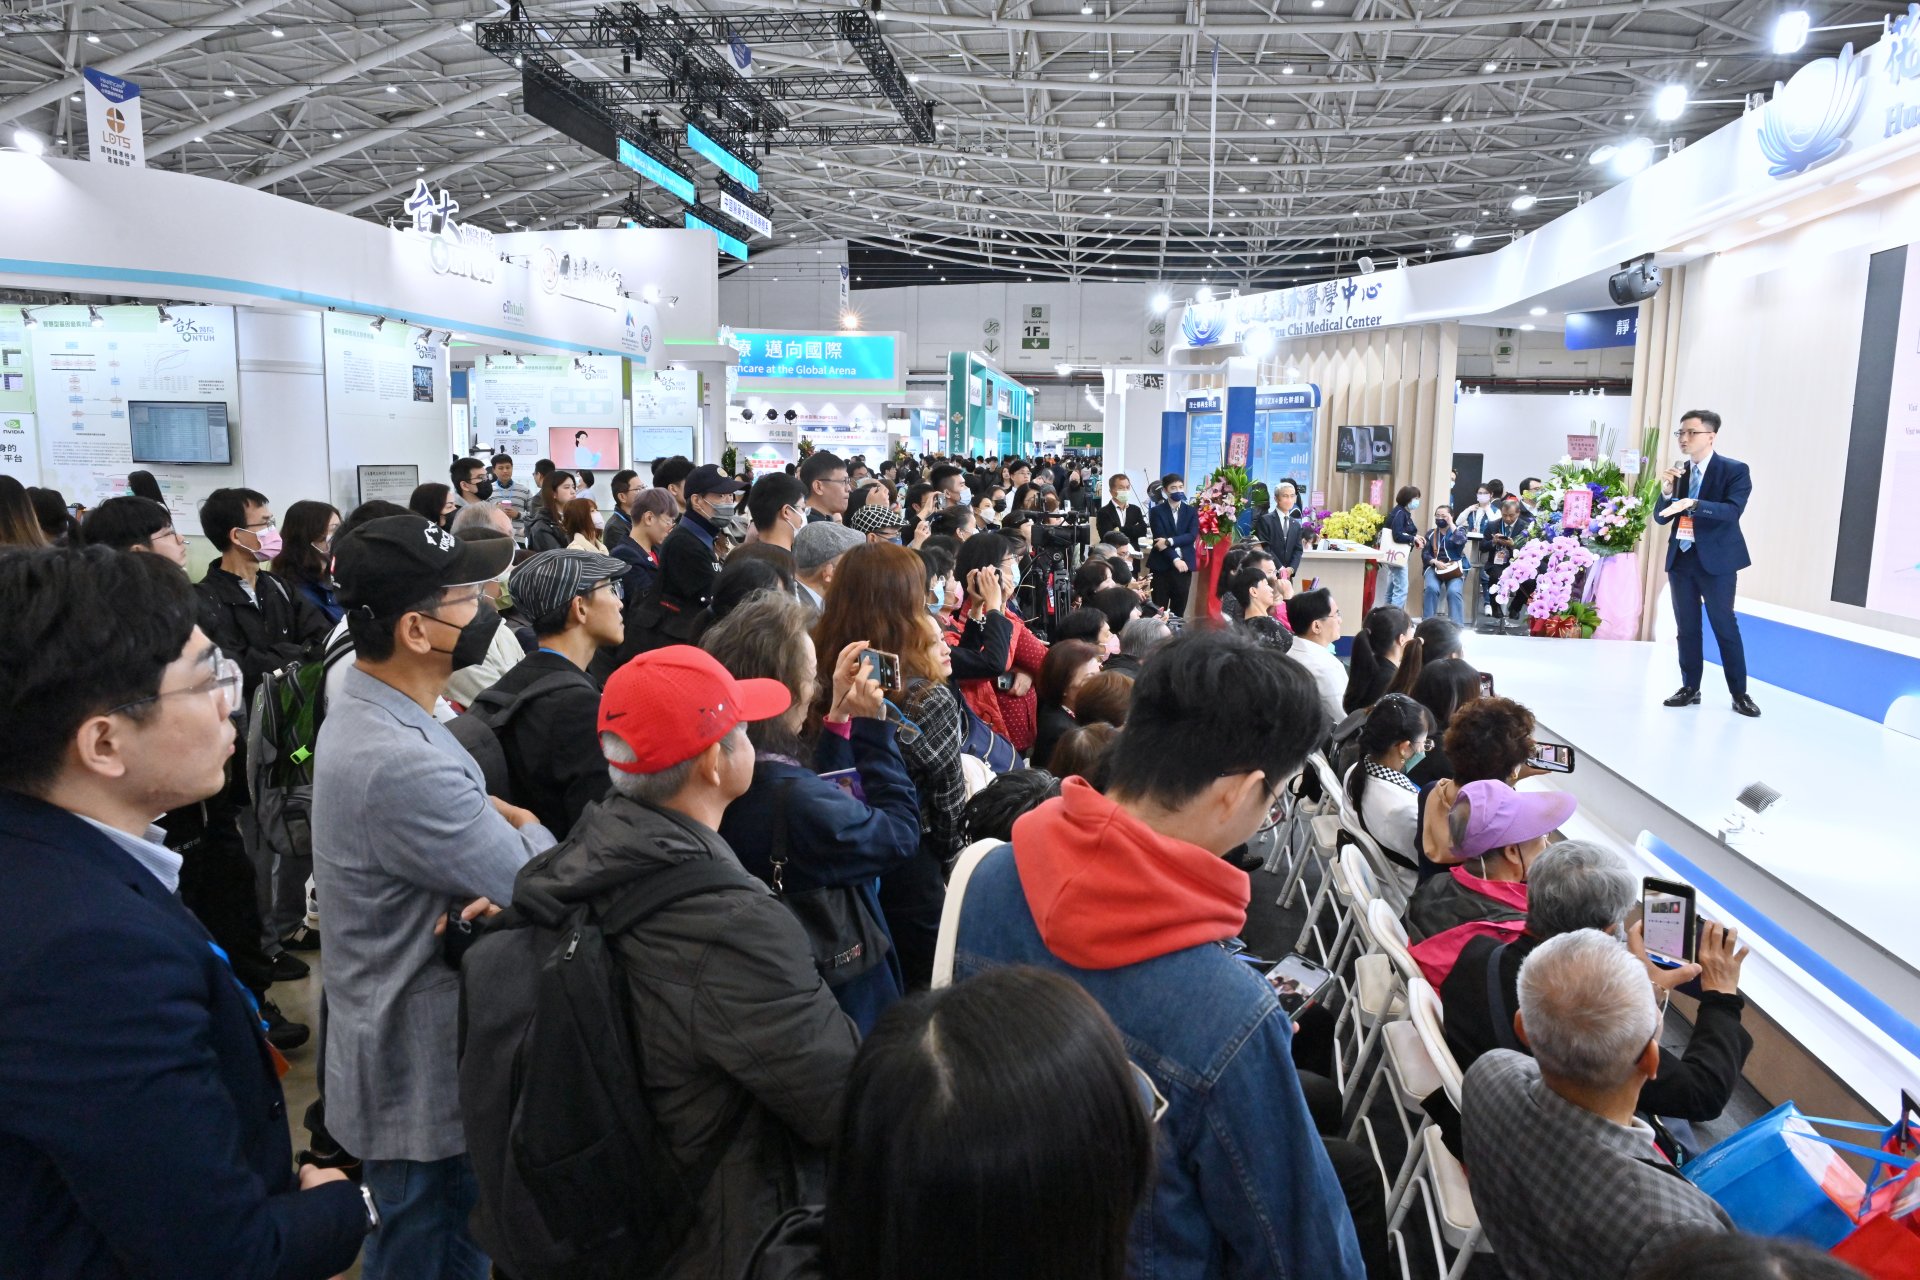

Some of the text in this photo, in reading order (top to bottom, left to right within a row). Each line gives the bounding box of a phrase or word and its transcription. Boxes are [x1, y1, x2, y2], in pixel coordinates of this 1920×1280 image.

[103, 130, 131, 149] LDTS
[1287, 323, 1303, 336] Chi
[1304, 316, 1343, 334] Medical
[1346, 314, 1383, 329] Center
[1616, 318, 1638, 335] 靜
[1025, 326, 1041, 337] 1F
[765, 340, 843, 359] 邁向國際
[766, 366, 775, 374] at
[778, 365, 794, 374] the
[796, 365, 827, 375] Global
[828, 366, 857, 375] Arena
[1052, 423, 1076, 431] North
[1071, 437, 1082, 445] 1F
[4, 454, 23, 463] 平台
